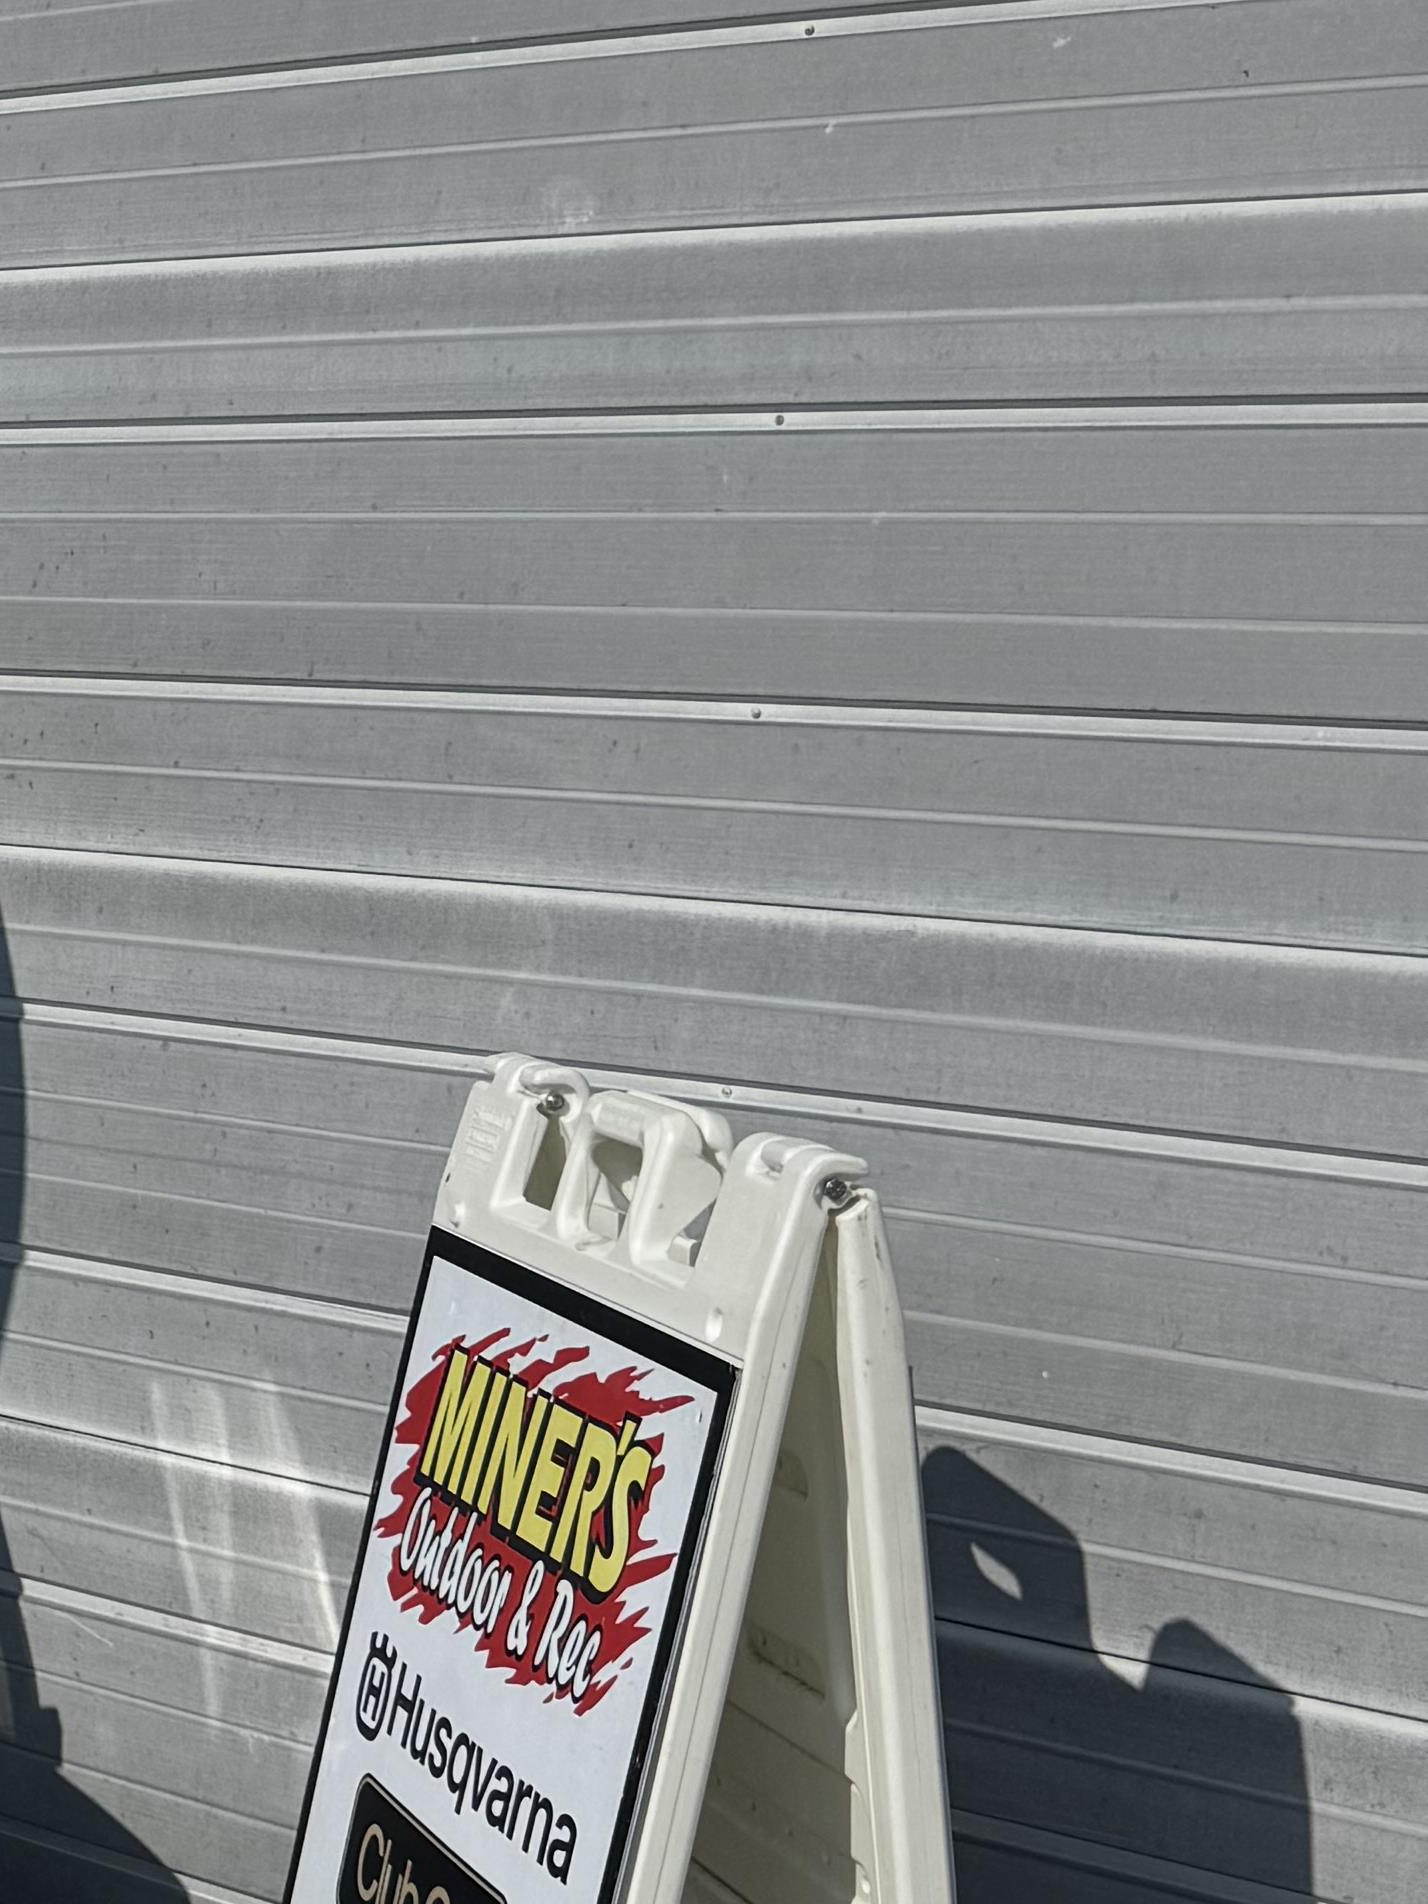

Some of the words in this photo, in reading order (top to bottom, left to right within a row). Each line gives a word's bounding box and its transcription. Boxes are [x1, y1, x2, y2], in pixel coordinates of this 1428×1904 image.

[415, 1345, 654, 1598] MINER'S
[399, 1486, 512, 1634] Outdoor
[507, 1559, 545, 1657] &
[536, 1578, 601, 1698] Rec
[387, 1662, 578, 1885] Husqvarna
